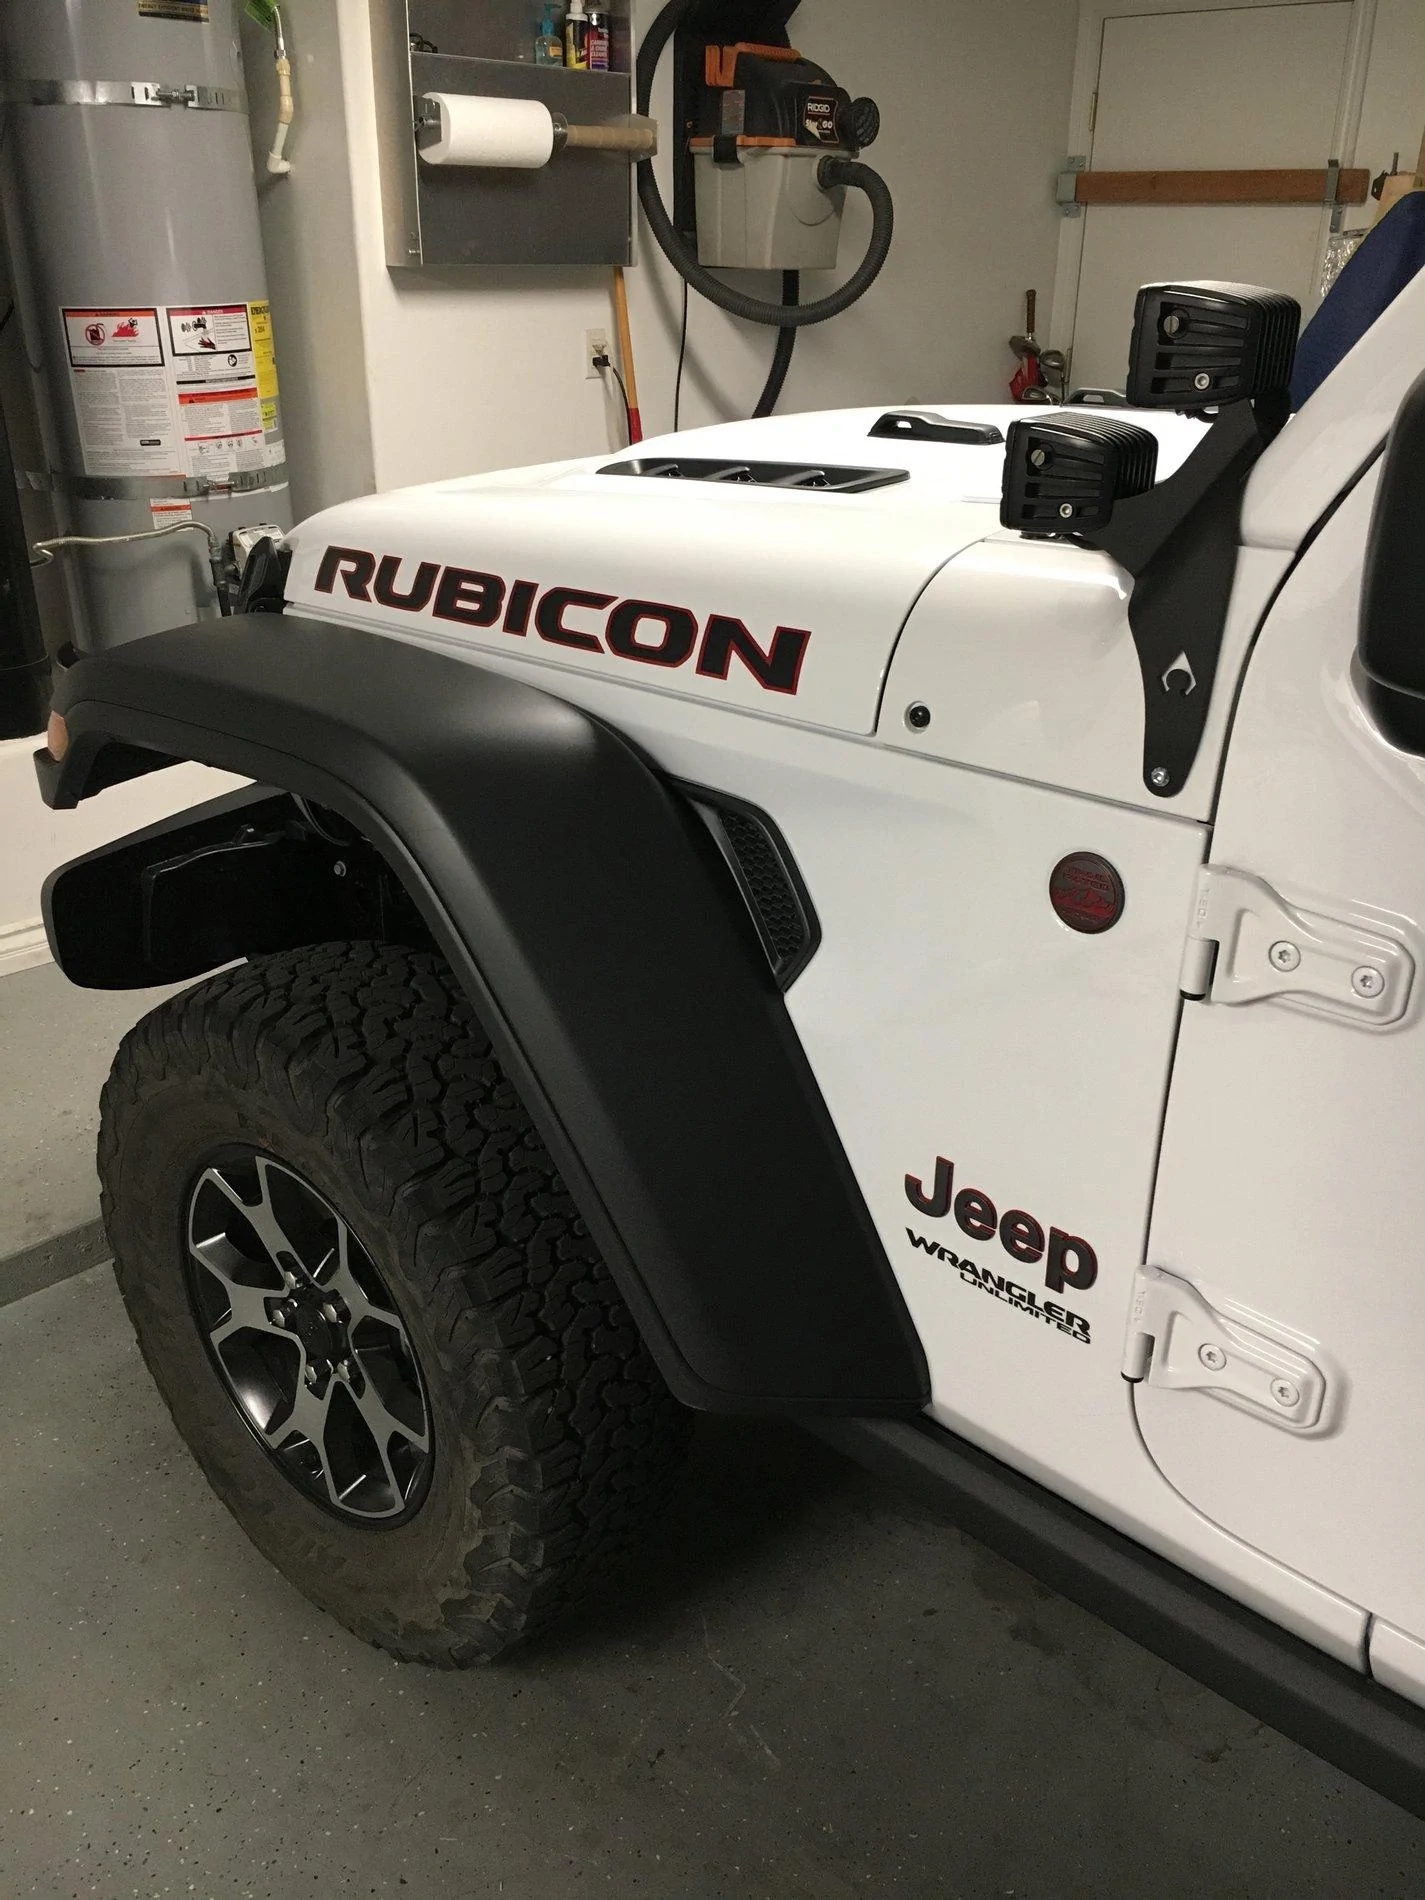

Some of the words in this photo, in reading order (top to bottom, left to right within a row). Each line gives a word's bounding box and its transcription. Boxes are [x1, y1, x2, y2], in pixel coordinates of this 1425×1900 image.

[807, 103, 830, 113] RIDGID
[314, 545, 812, 696] RUBICON
[904, 1155, 1099, 1294] Jeep
[906, 1226, 1092, 1338] WRANGLER
[960, 1271, 1092, 1345] UNLIMITED
